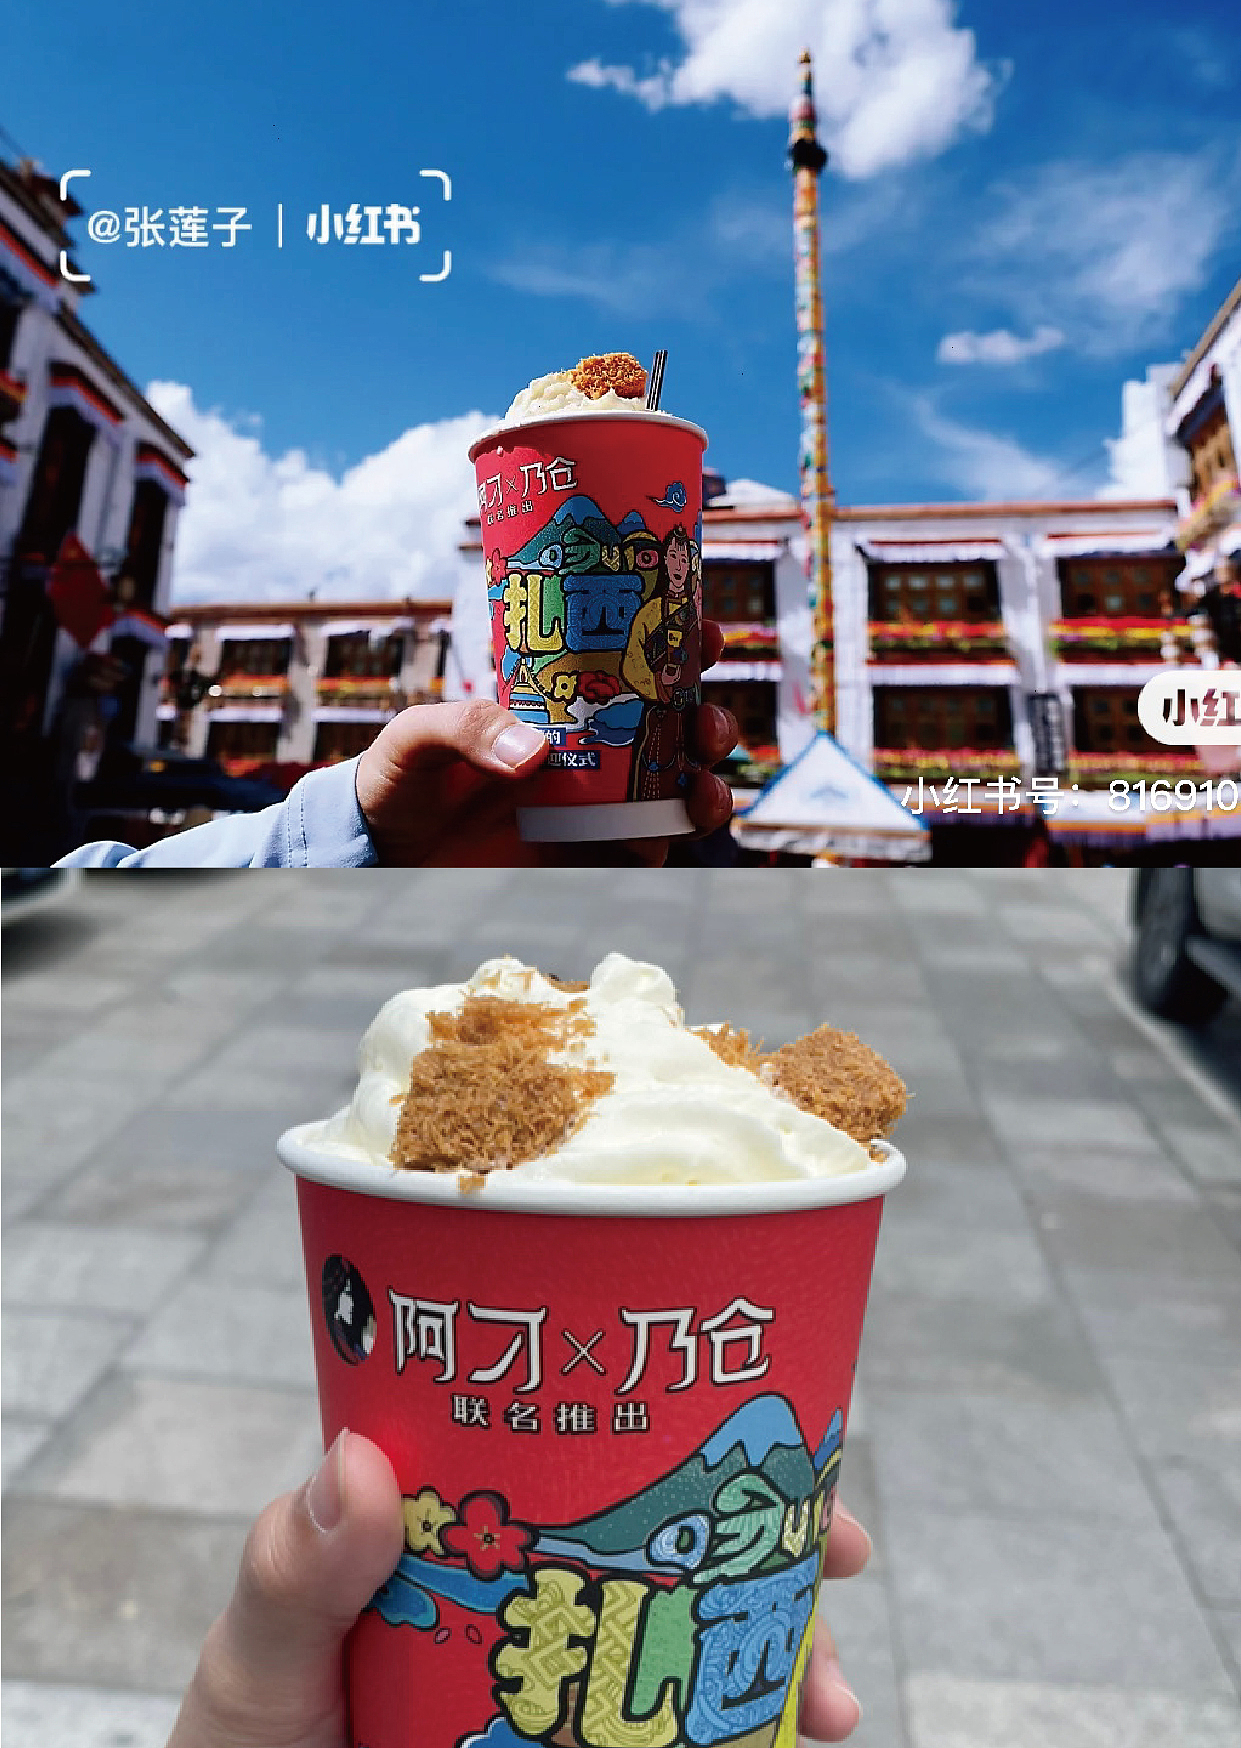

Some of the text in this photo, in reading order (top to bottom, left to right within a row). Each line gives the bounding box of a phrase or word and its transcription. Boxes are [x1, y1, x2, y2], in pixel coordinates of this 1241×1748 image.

[502, 571, 645, 652] 扎西
[450, 1394, 650, 1435] 联名推出
